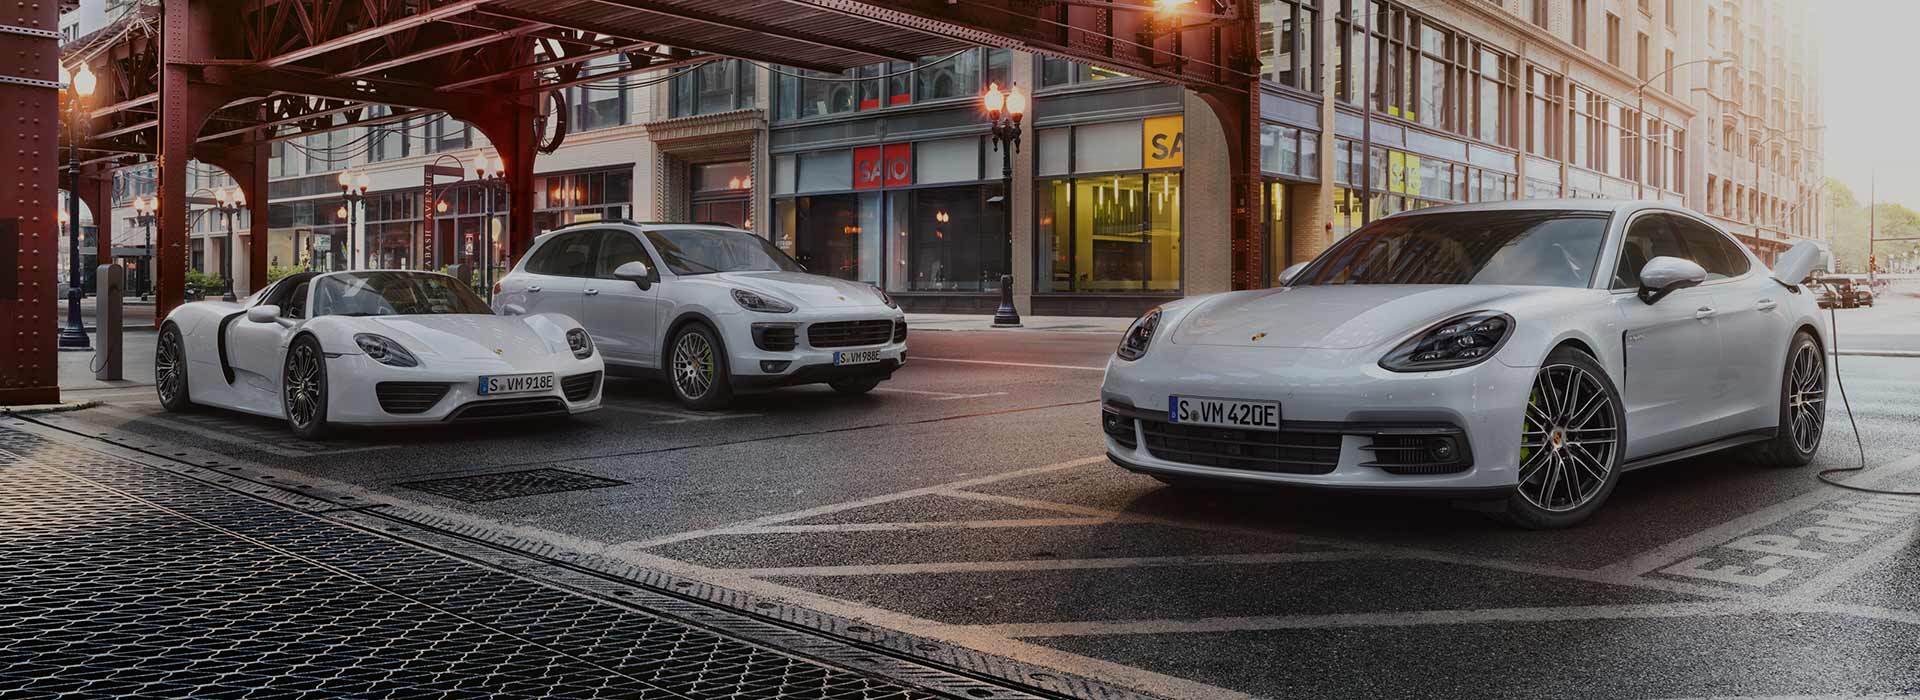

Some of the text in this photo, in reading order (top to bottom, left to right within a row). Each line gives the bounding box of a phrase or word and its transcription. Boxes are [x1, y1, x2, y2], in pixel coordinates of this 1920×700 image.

[424, 230, 432, 272] ABASH
[840, 352, 846, 364] S
[489, 375, 553, 391] S VM 918E
[1179, 400, 1277, 427] S VM 420E
